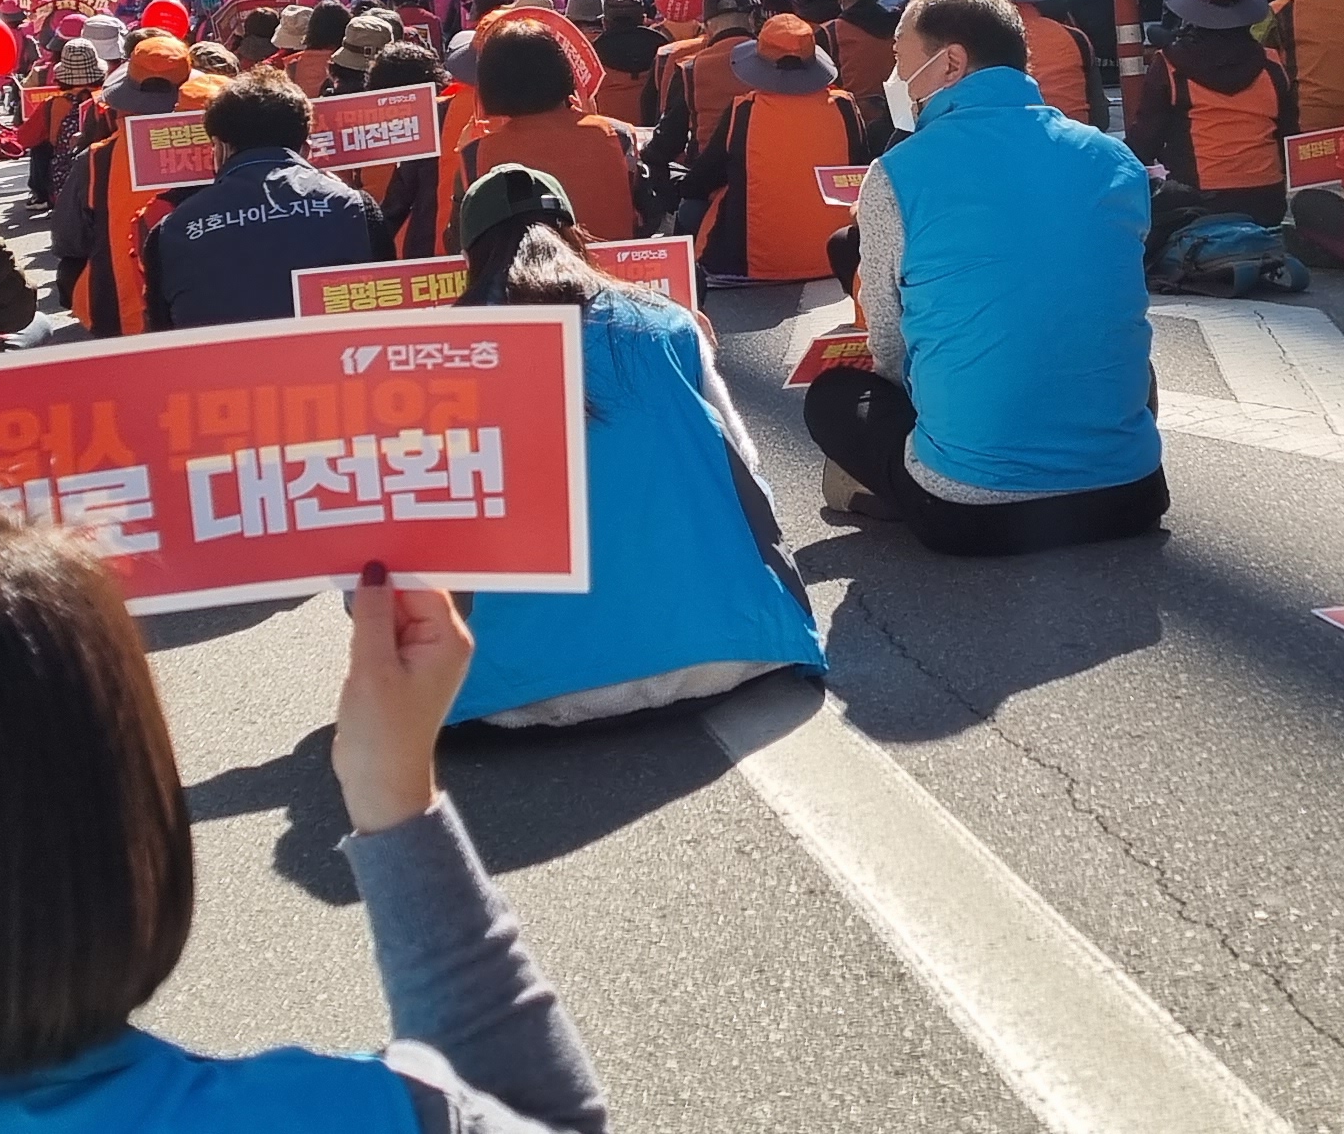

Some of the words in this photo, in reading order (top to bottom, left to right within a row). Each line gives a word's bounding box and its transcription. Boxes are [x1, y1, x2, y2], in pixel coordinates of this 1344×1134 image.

[342, 115, 420, 149] 대전환!
[185, 198, 332, 241] 청호나이스지부
[631, 249, 668, 261] 민주노총
[323, 277, 404, 314] 불평등
[387, 342, 500, 371] 민주노총
[185, 425, 506, 544] 대전환!
